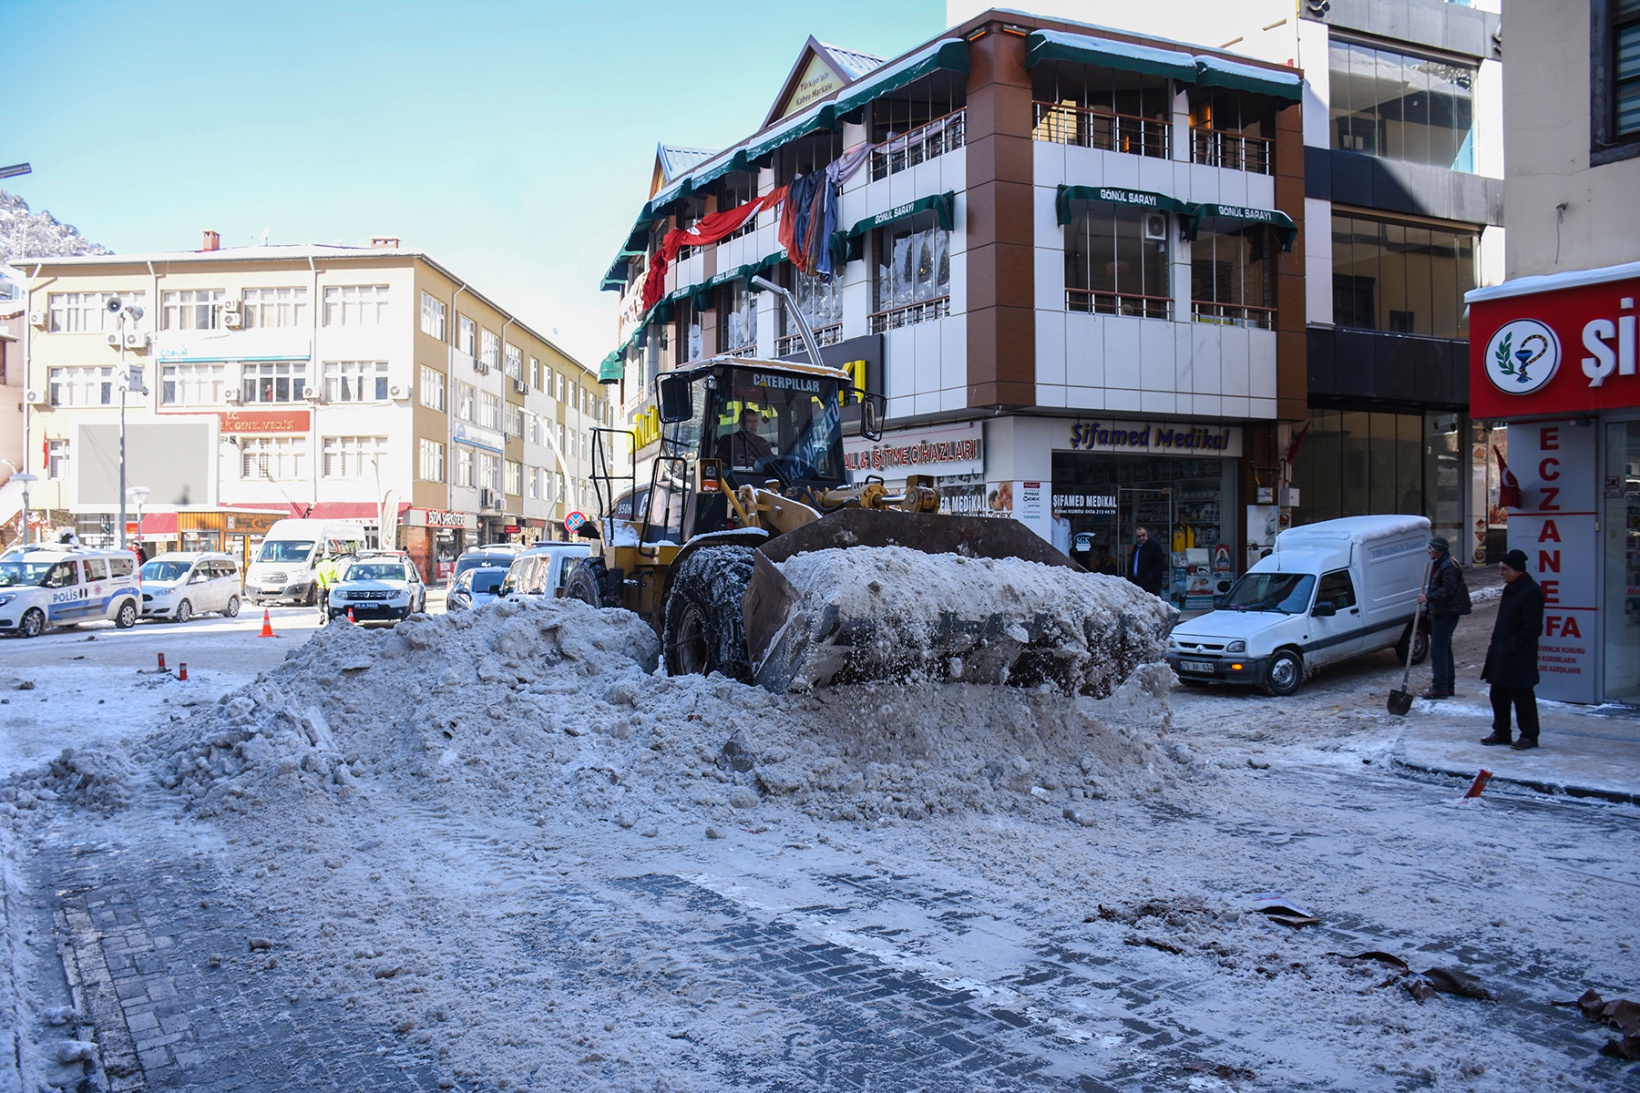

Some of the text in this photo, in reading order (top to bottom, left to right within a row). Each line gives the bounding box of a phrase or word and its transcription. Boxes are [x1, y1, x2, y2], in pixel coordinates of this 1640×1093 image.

[1100, 188, 1157, 206] GÖNÜL SARAYI
[893, 202, 915, 218] SARAYI
[1218, 205, 1272, 221] GÖNÜL SARAYI
[1581, 297, 1637, 388] Şİ
[753, 373, 820, 393] CATERPILLAR
[226, 411, 240, 420] T.C.
[234, 421, 261, 430] GENEL
[1071, 423, 1231, 450] Şifamed Medikal
[844, 439, 978, 471] AL & İŞİTME CİHAZLARI
[940, 496, 950, 512] ED
[1538, 427, 1561, 604] ECZANE
[53, 588, 78, 603] POLİS
[1545, 615, 1582, 639] FA
